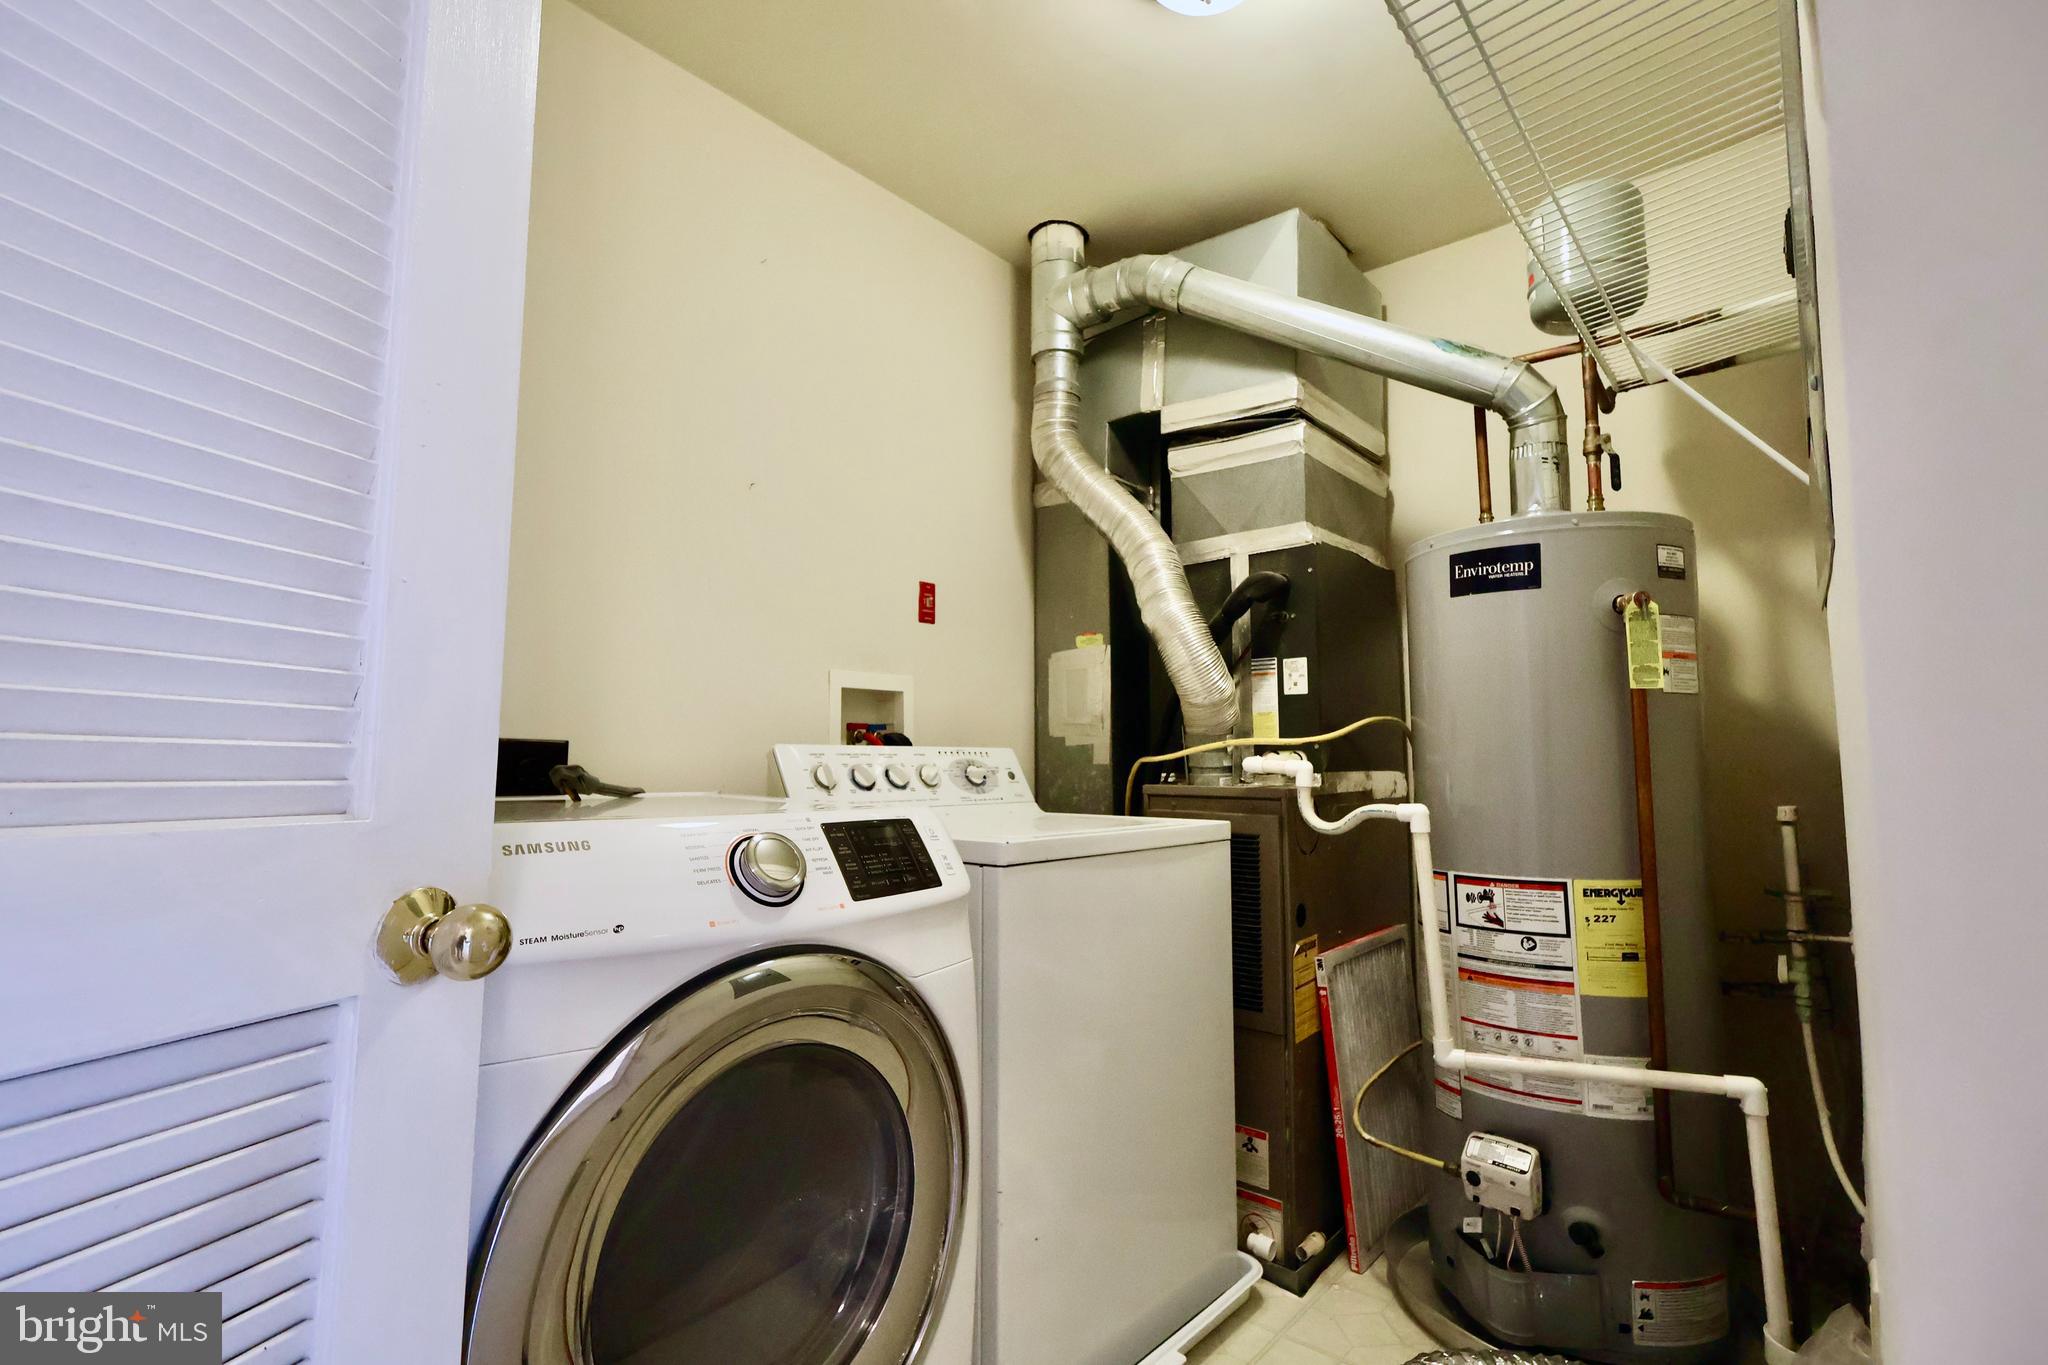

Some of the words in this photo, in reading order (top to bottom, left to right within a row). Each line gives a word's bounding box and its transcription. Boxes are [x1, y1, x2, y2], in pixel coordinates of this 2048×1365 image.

[1454, 561, 1534, 579] Envirotemp
[502, 840, 592, 857] SAMSUNG
[519, 936, 548, 946] STEAM
[550, 928, 609, 943] MoistureSensor
[1316, 958, 1324, 972] 3M
